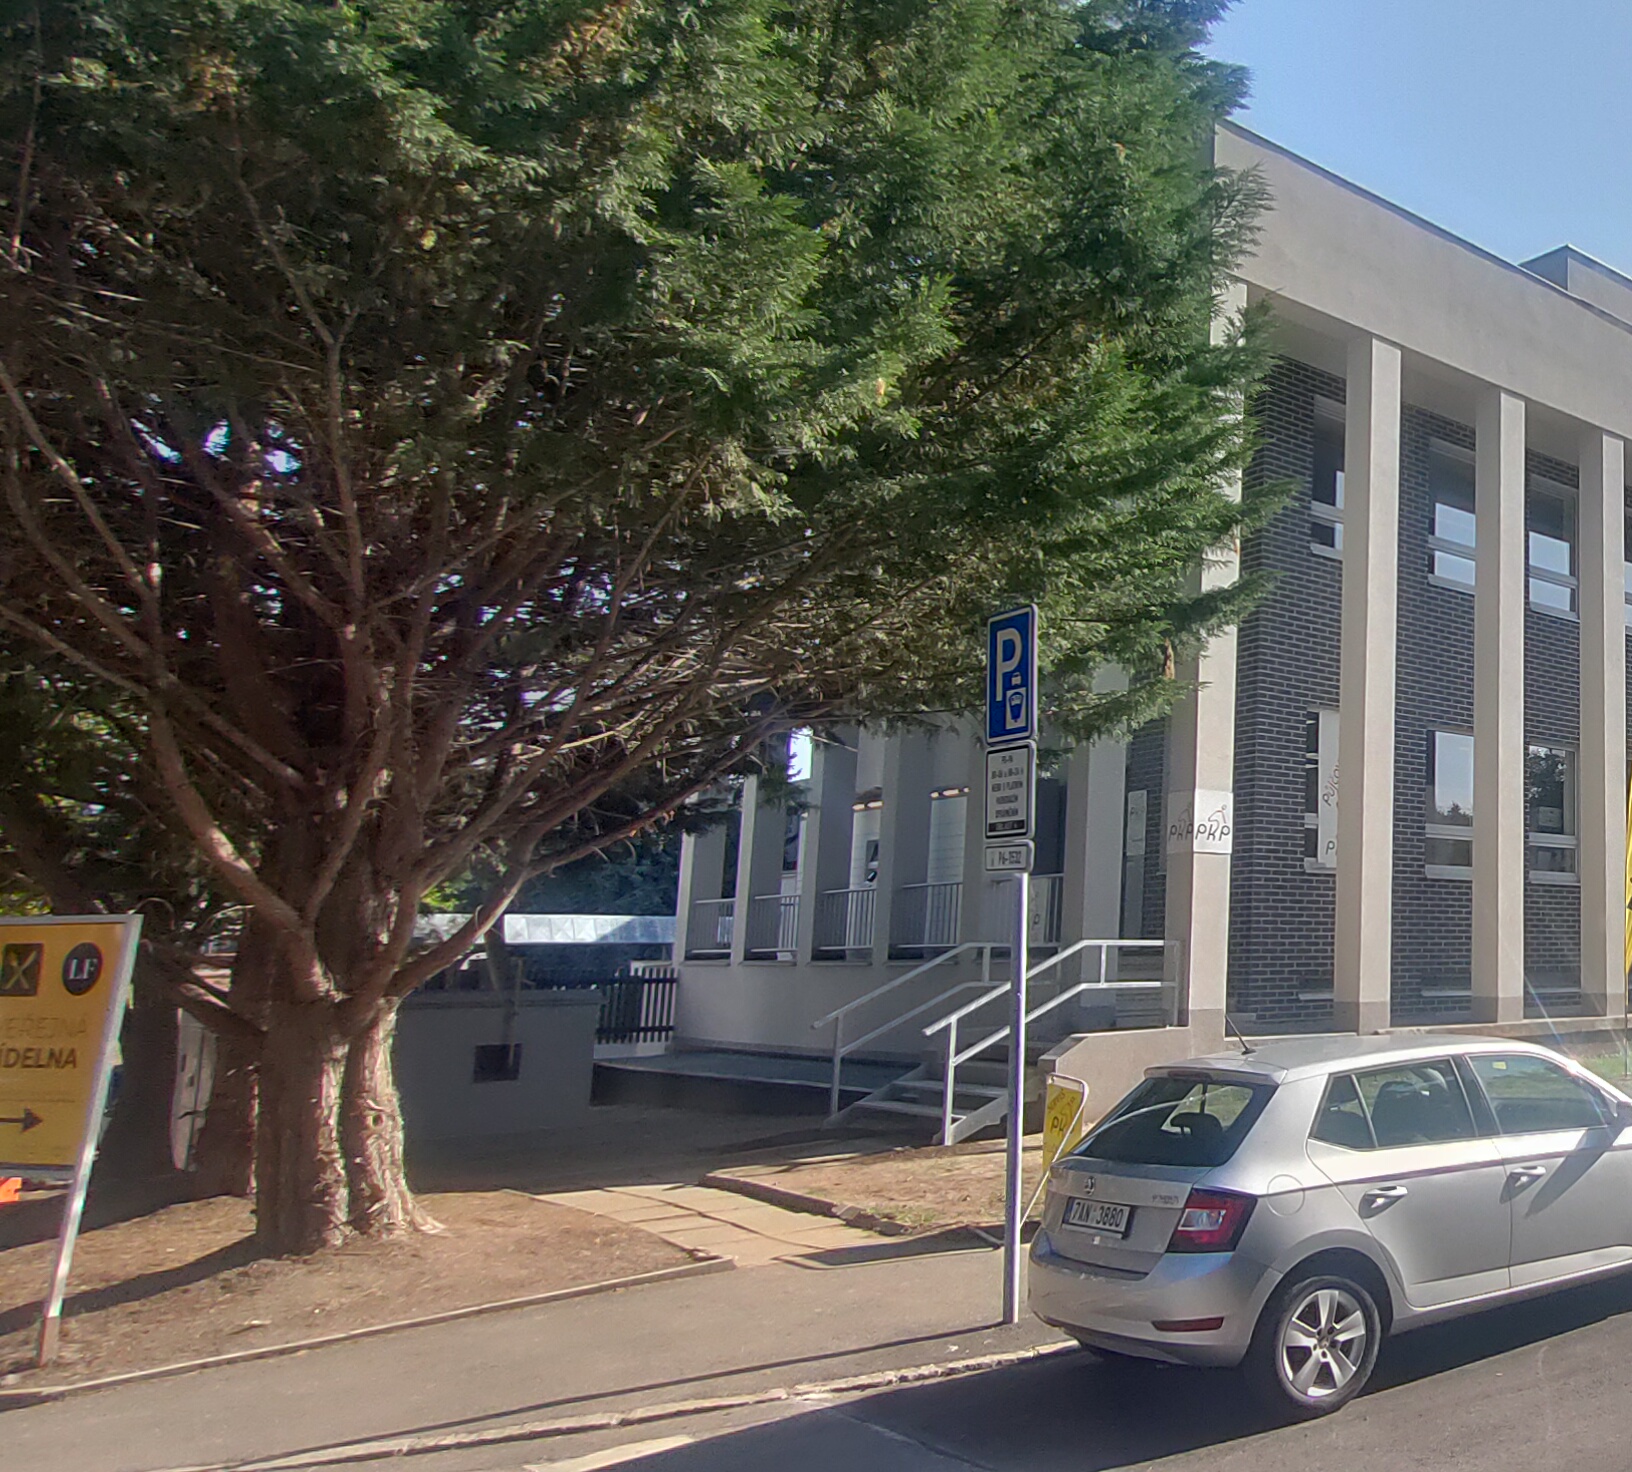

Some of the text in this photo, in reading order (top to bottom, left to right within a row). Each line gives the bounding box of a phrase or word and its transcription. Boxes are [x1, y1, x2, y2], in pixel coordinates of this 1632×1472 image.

[996, 627, 1023, 702] P
[68, 957, 99, 980] LF
[1071, 1202, 1124, 1228] 7AN 3880
